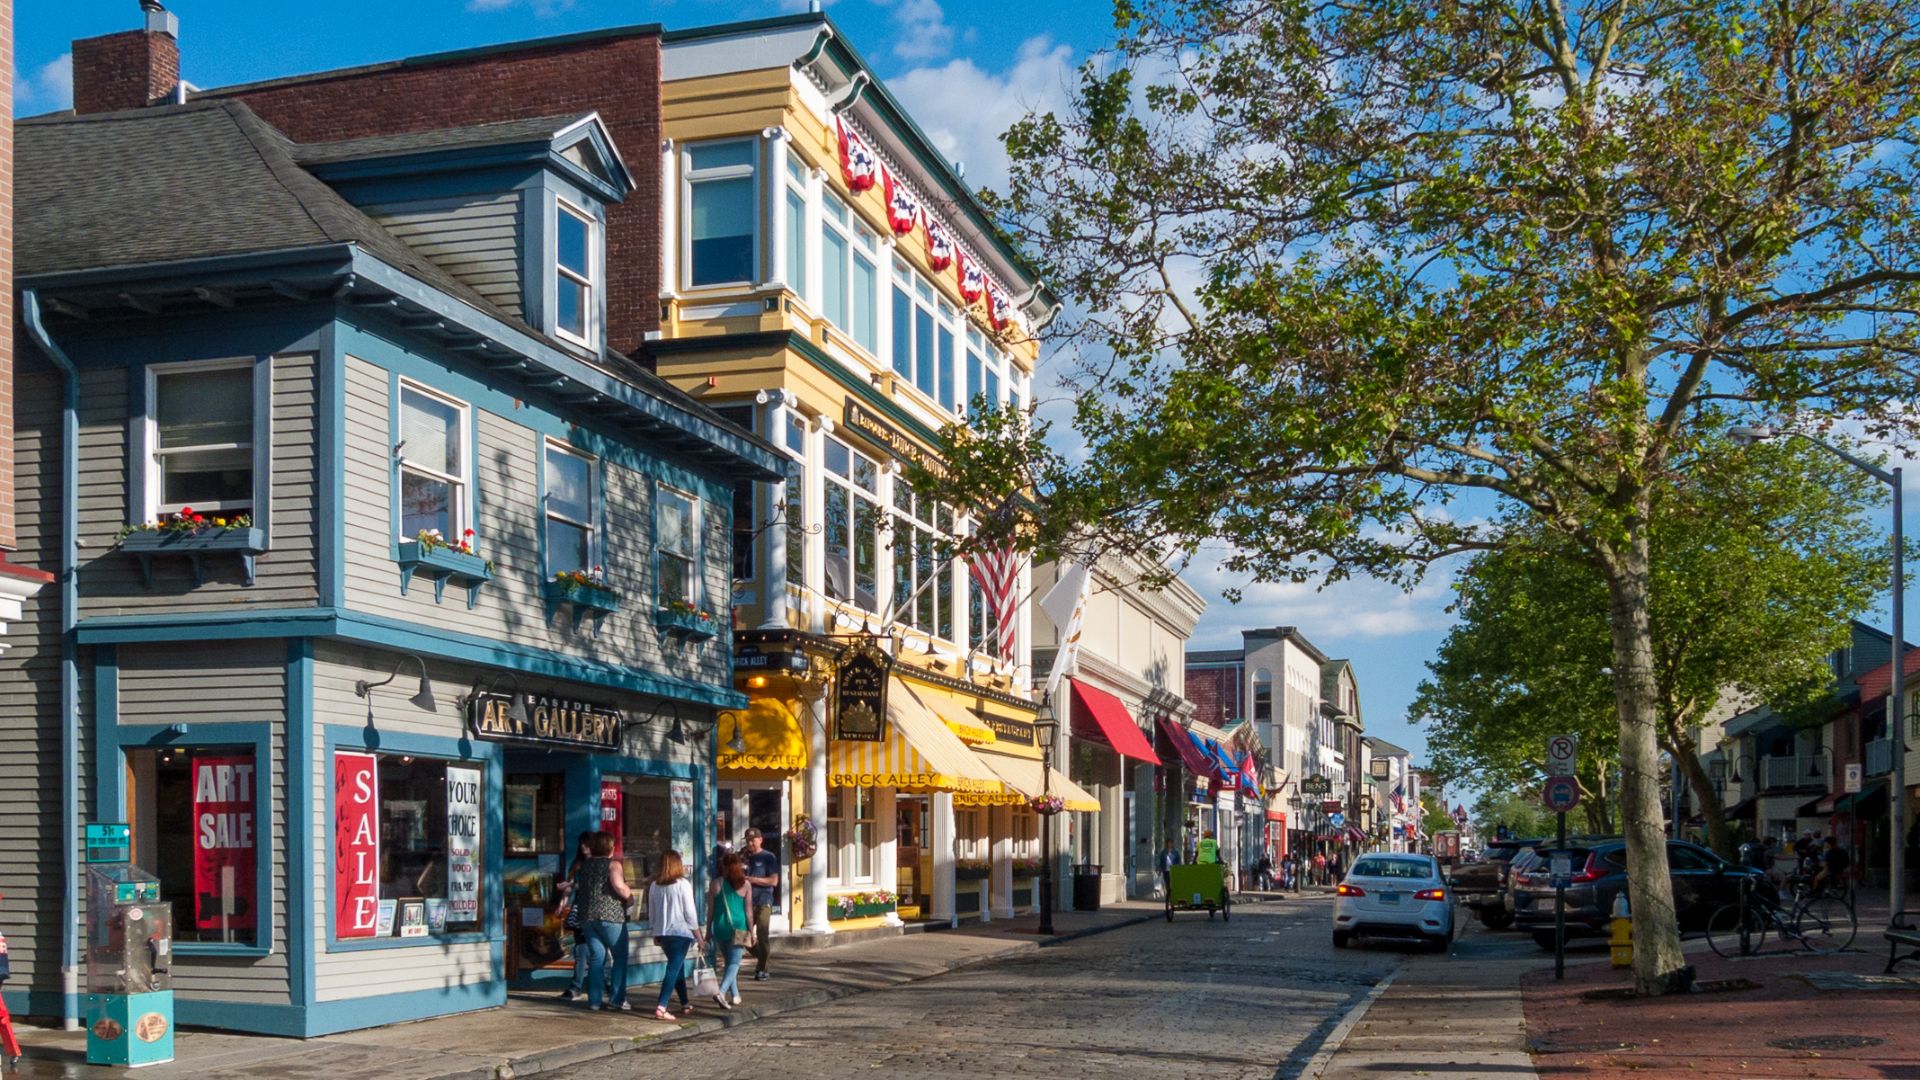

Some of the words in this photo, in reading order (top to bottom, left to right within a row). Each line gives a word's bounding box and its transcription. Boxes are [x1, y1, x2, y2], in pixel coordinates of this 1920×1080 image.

[521, 694, 592, 712] EASIDE
[534, 705, 617, 745] GALLERY
[722, 753, 766, 765] BRICK
[769, 754, 802, 766] ALLEY
[196, 765, 253, 802] ART
[835, 774, 882, 785] BRICK
[887, 772, 937, 785] ALLEY
[449, 780, 477, 805] YOUR
[953, 793, 985, 803] BRICK
[987, 793, 1021, 804] ALLEY
[200, 813, 252, 849] SALE
[352, 770, 376, 930] SALE
[451, 848, 470, 857] SOLID
[451, 881, 474, 892] FRAME
